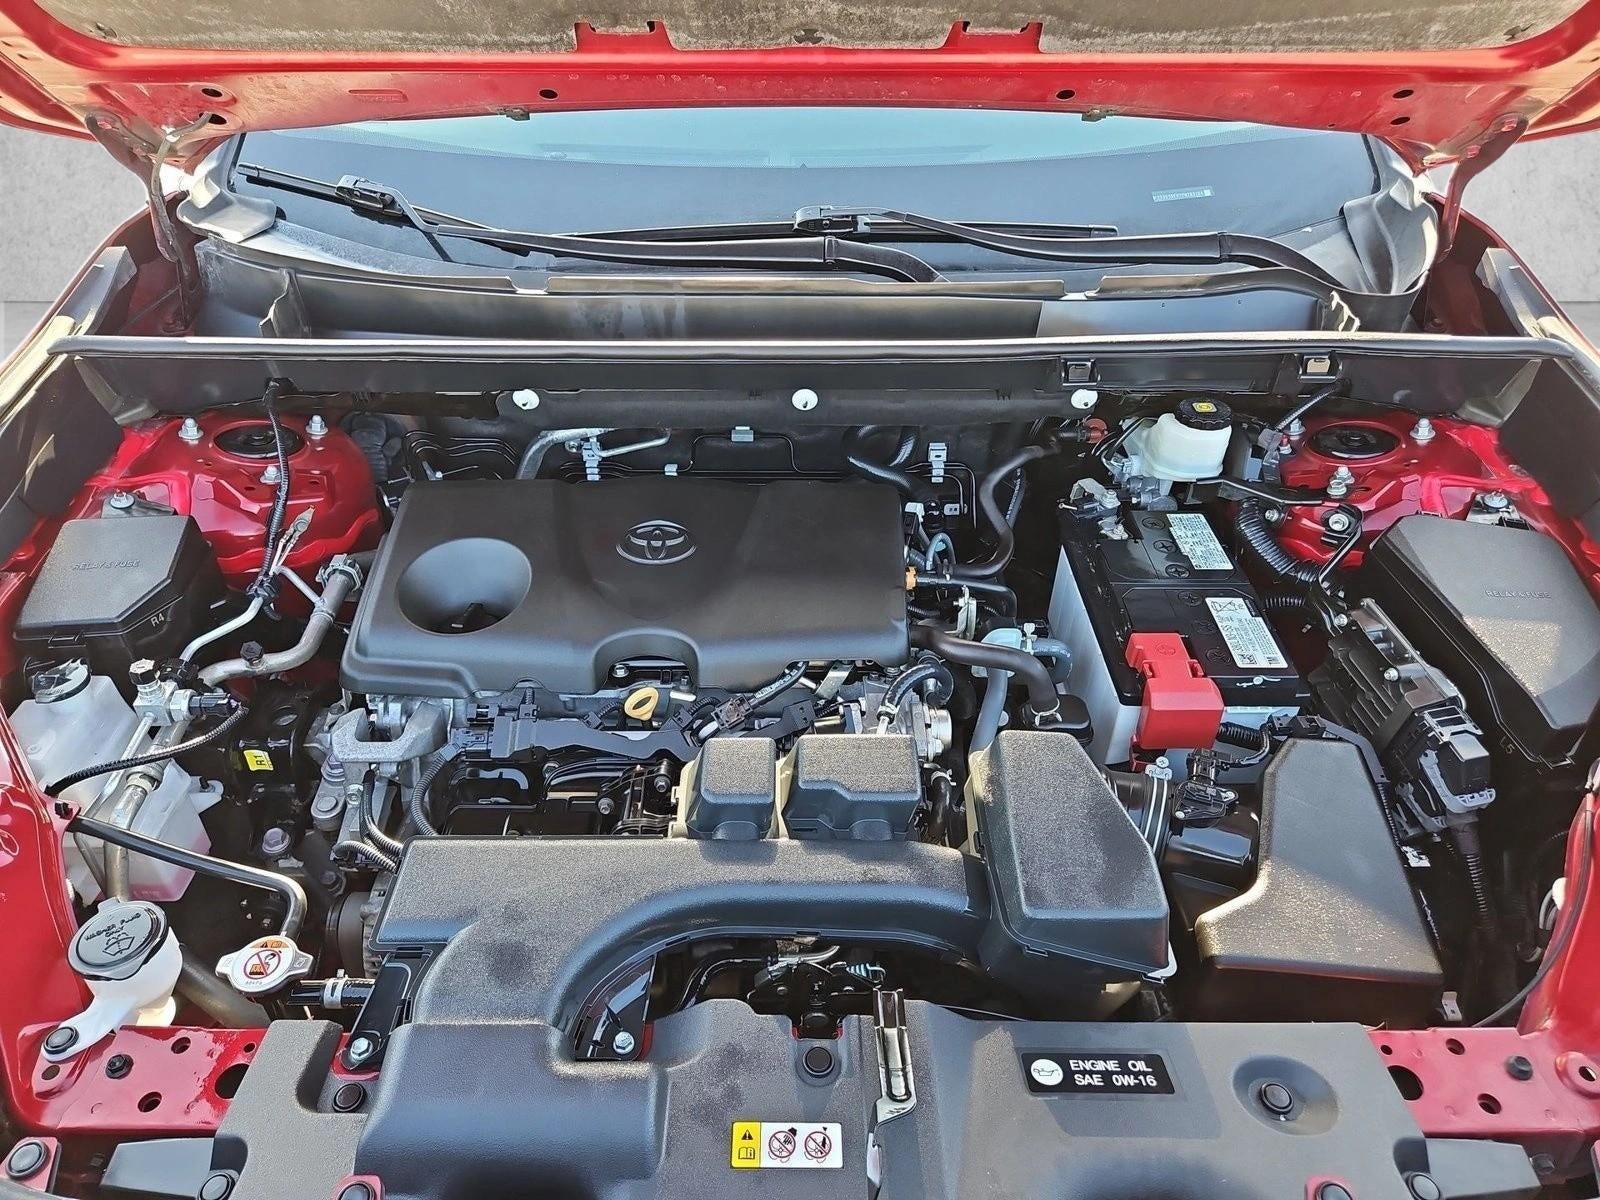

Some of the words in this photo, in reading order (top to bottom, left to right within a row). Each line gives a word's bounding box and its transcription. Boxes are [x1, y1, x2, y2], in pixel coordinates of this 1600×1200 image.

[150, 613, 165, 627] R4
[254, 755, 266, 766] R1
[1069, 1060, 1121, 1071] ENGINE
[1127, 1061, 1152, 1072] OIL
[1074, 1075, 1104, 1086] SAE
[1112, 1075, 1157, 1087] 0W-16
